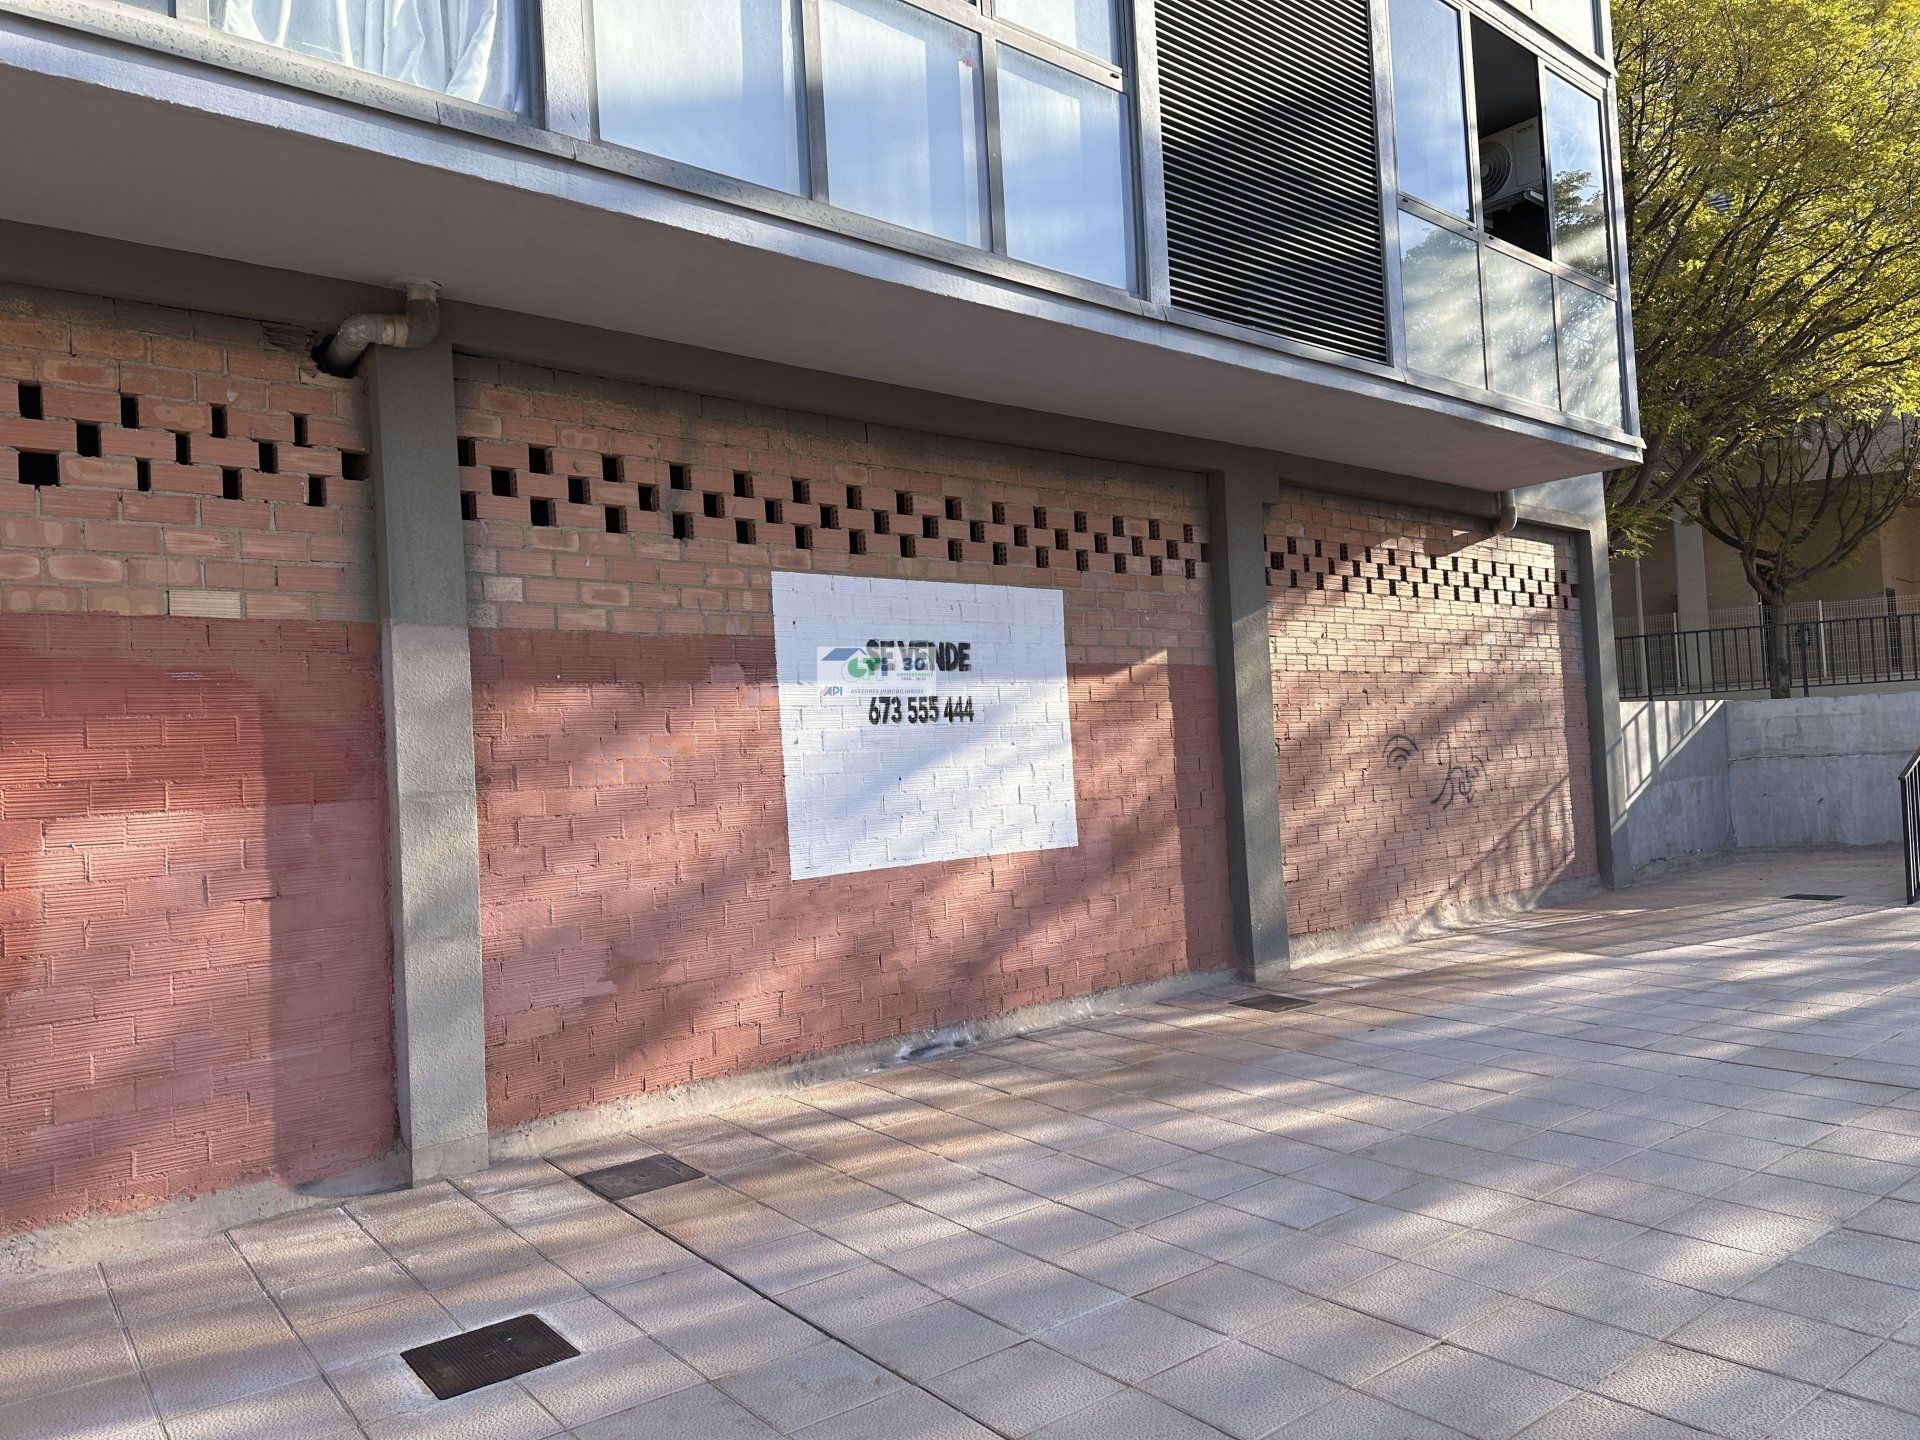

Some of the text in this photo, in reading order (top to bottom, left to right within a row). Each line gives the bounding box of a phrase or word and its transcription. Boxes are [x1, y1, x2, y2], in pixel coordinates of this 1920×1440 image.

[866, 639, 971, 672] SE VENDE
[869, 695, 974, 725] 673 555 444
